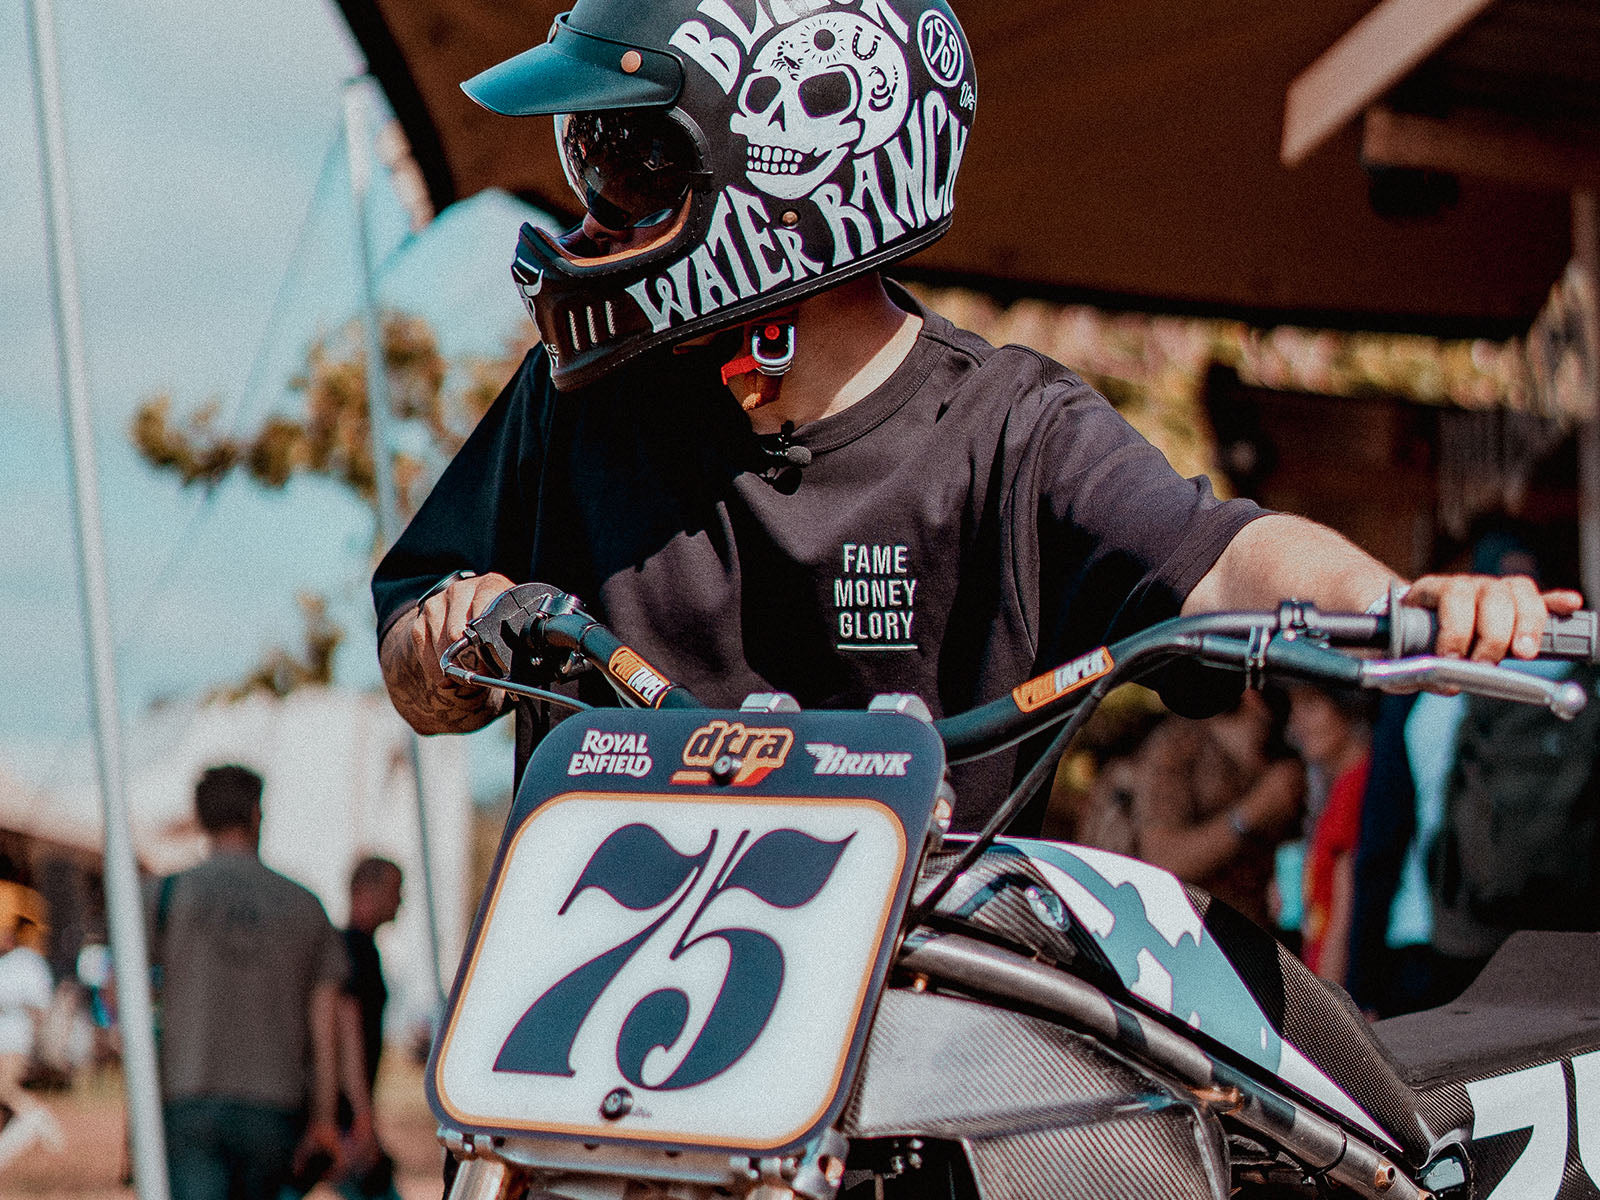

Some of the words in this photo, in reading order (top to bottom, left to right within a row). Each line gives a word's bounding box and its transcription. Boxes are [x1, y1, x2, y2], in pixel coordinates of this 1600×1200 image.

[624, 184, 825, 334] WATER
[809, 90, 969, 267] RANCH
[842, 543, 909, 574] FAME
[834, 578, 918, 608] MONEY
[839, 610, 915, 640] GLORY
[581, 728, 650, 755] ROYAL
[567, 752, 654, 779] ENFIELD
[805, 743, 913, 777] BRINK
[491, 821, 859, 1092] 75
[1464, 1049, 1600, 1200] 7
